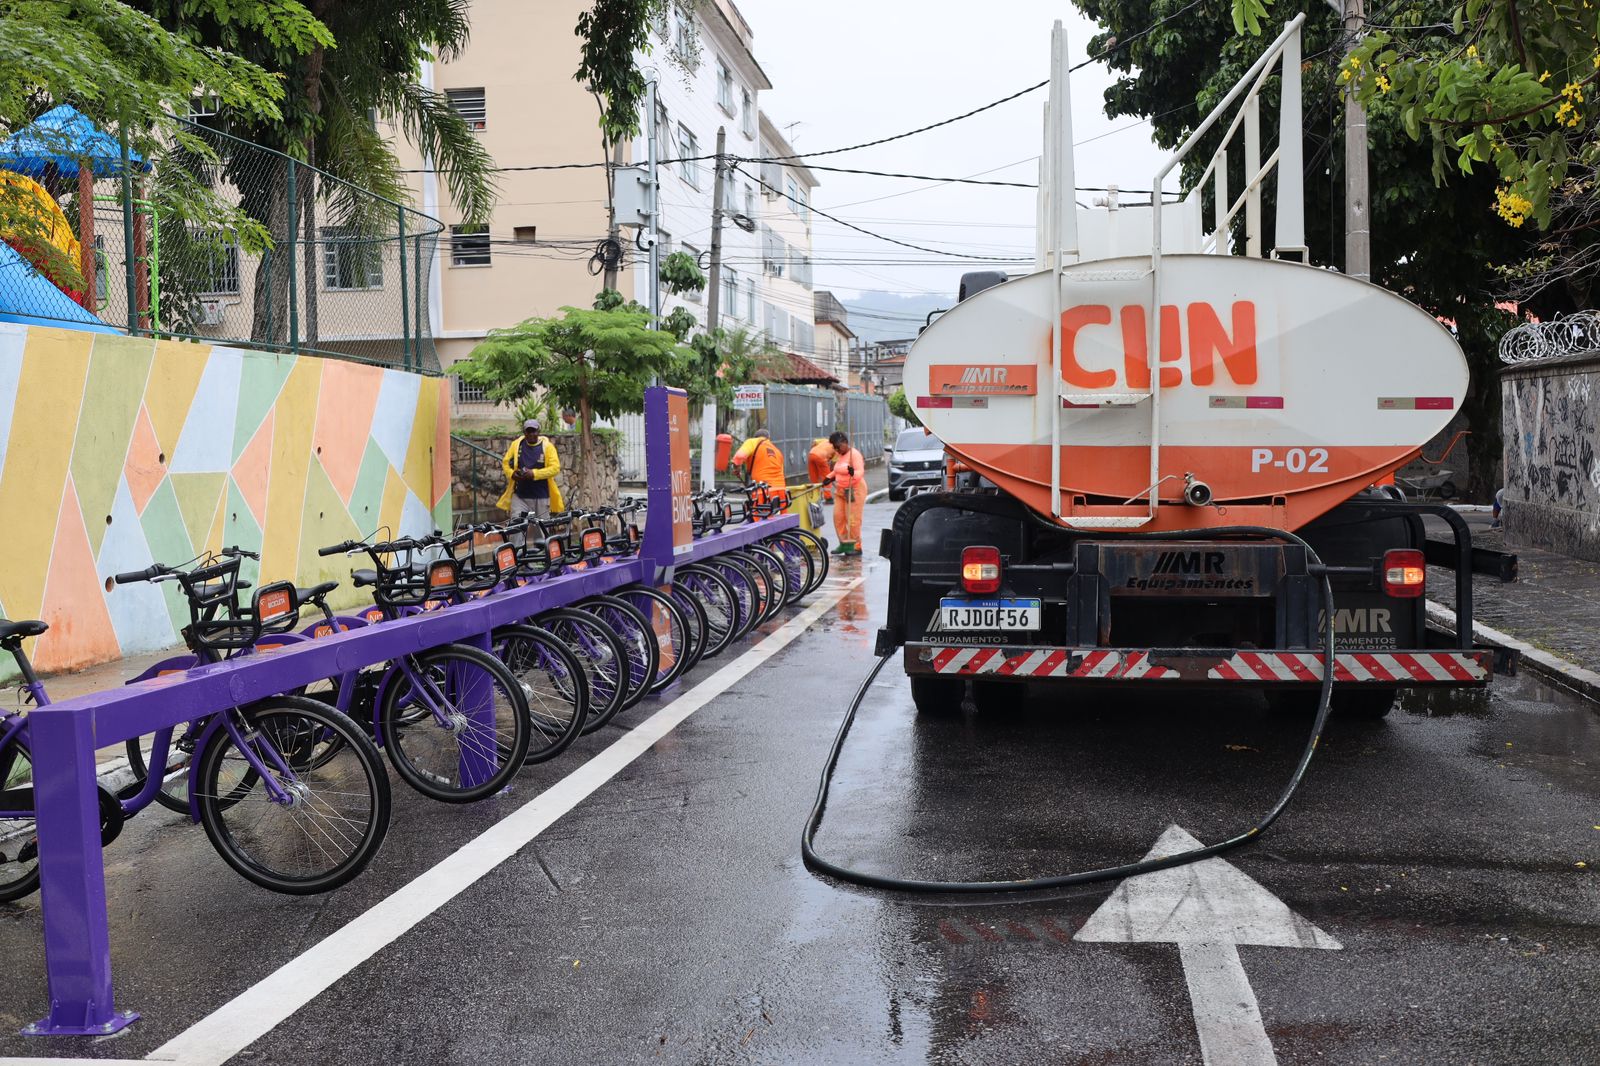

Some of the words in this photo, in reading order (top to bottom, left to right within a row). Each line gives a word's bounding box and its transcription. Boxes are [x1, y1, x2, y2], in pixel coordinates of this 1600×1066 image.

[1251, 448, 1329, 473] P-02
[673, 495, 692, 525] BIKE
[1126, 577, 1253, 590] Equipamentos
[922, 636, 1009, 644] EQUIPAMENTOS
